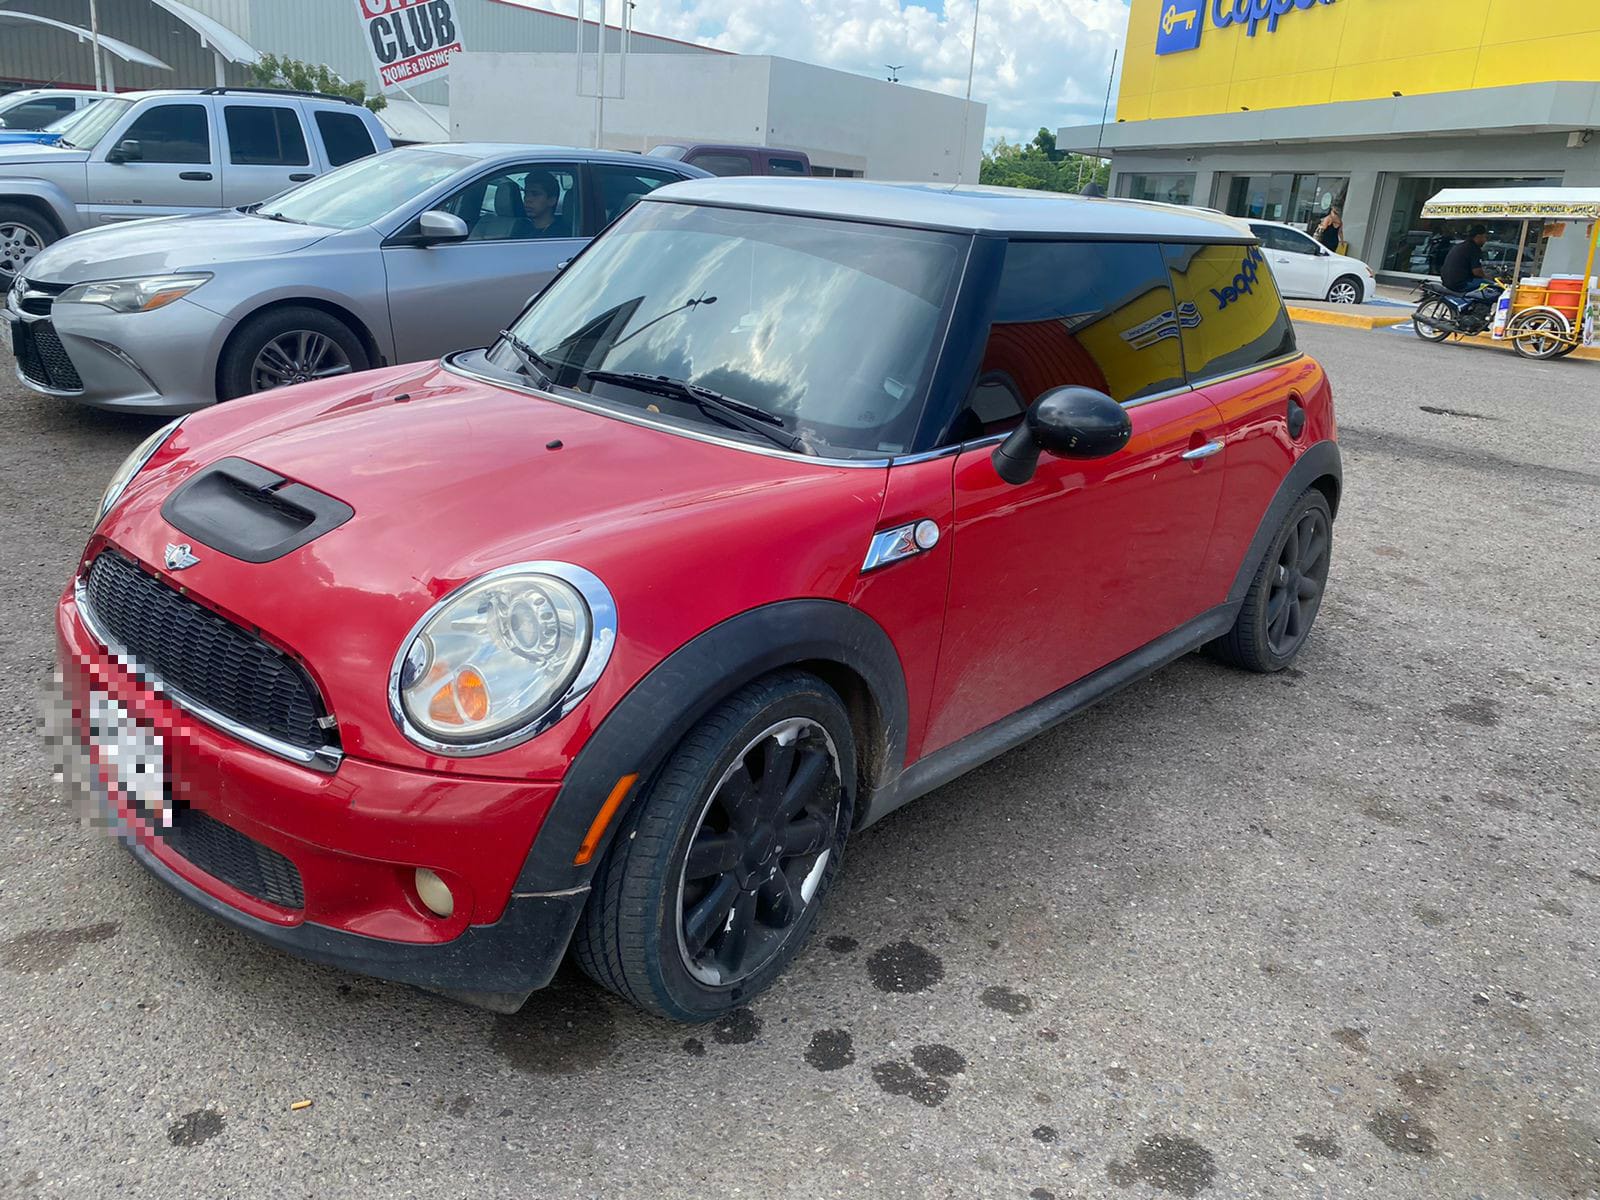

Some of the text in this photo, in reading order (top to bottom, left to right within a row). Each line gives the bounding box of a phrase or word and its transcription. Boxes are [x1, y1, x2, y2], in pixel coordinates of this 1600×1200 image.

[370, 0, 456, 63] CLUB
[1212, 0, 1336, 37] Copp
[418, 46, 461, 72] BUSINE
[1462, 205, 1478, 214] COCO
